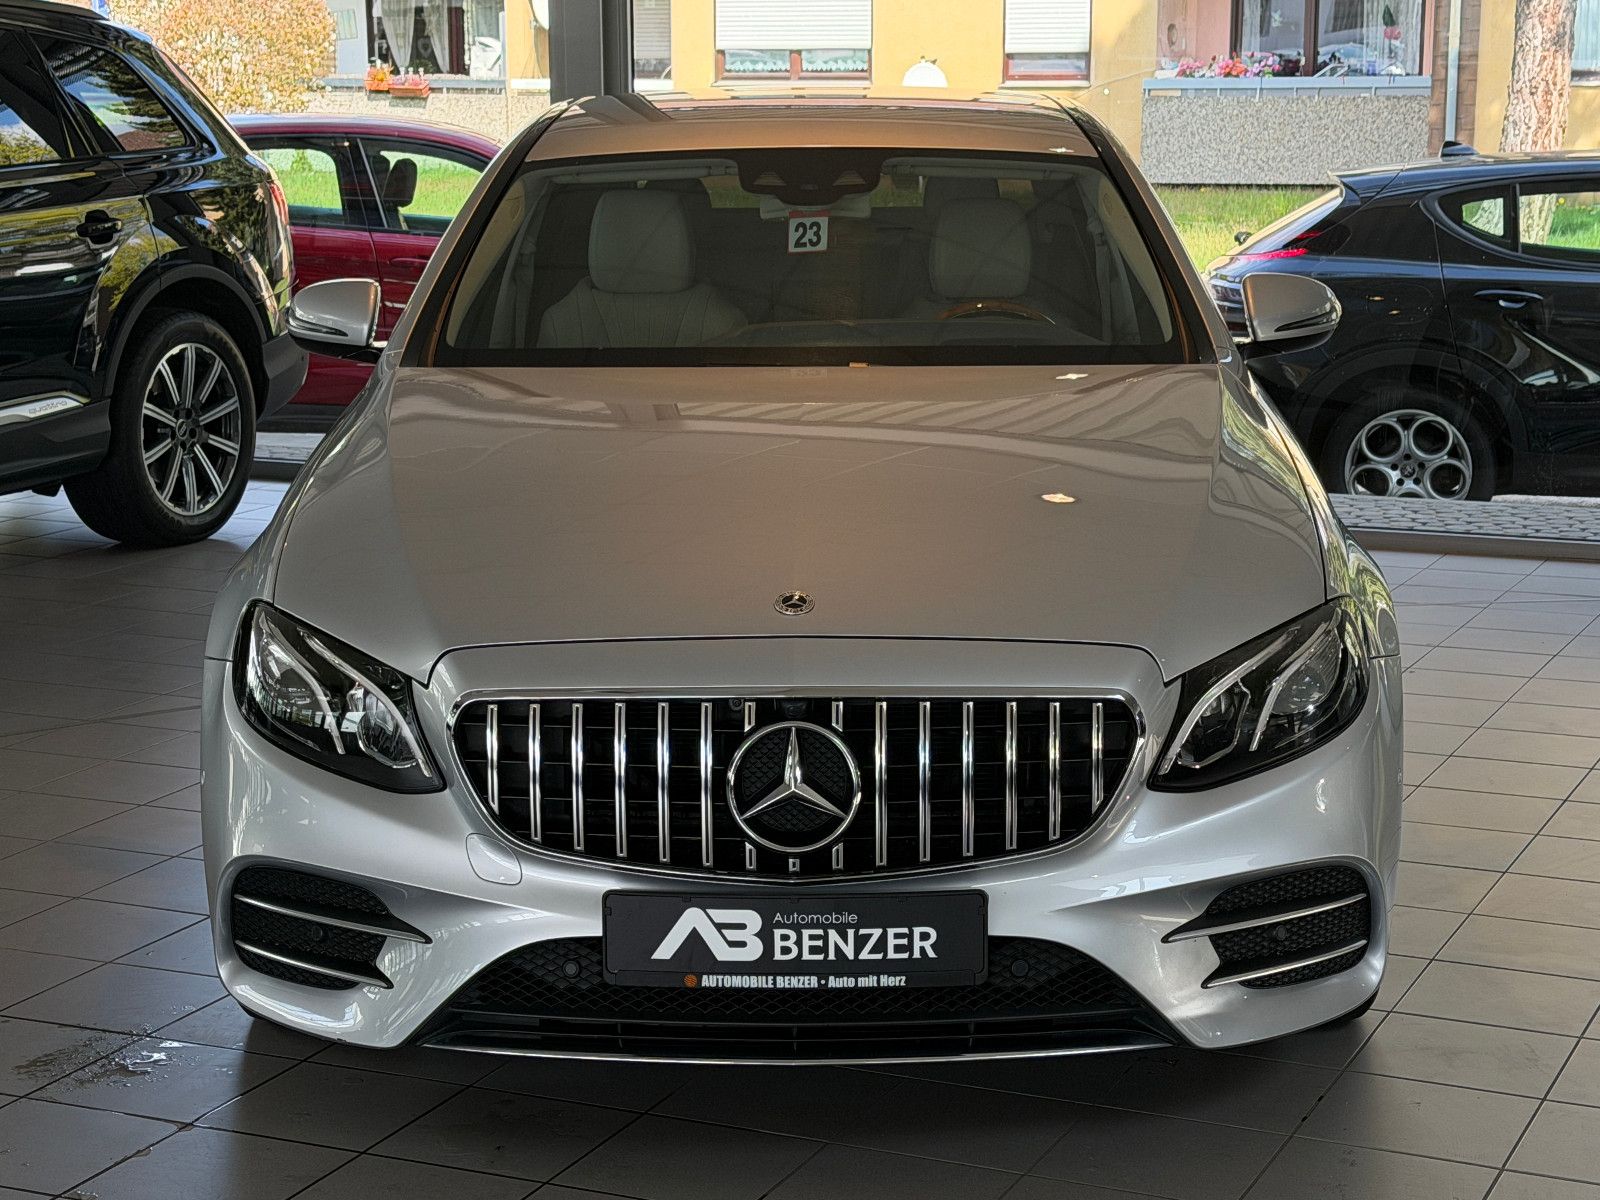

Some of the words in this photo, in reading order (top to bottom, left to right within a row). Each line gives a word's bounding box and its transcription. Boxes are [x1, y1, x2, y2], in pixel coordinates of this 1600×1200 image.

[793, 221, 822, 249] 23
[772, 911, 858, 924] Automobile
[650, 906, 764, 962] AB
[772, 926, 938, 961] BENZER
[701, 974, 774, 988] AUTOMOBILE
[776, 975, 819, 989] BENZER
[827, 975, 856, 988] Auto
[857, 974, 878, 987] mit
[879, 974, 907, 987] Herz
